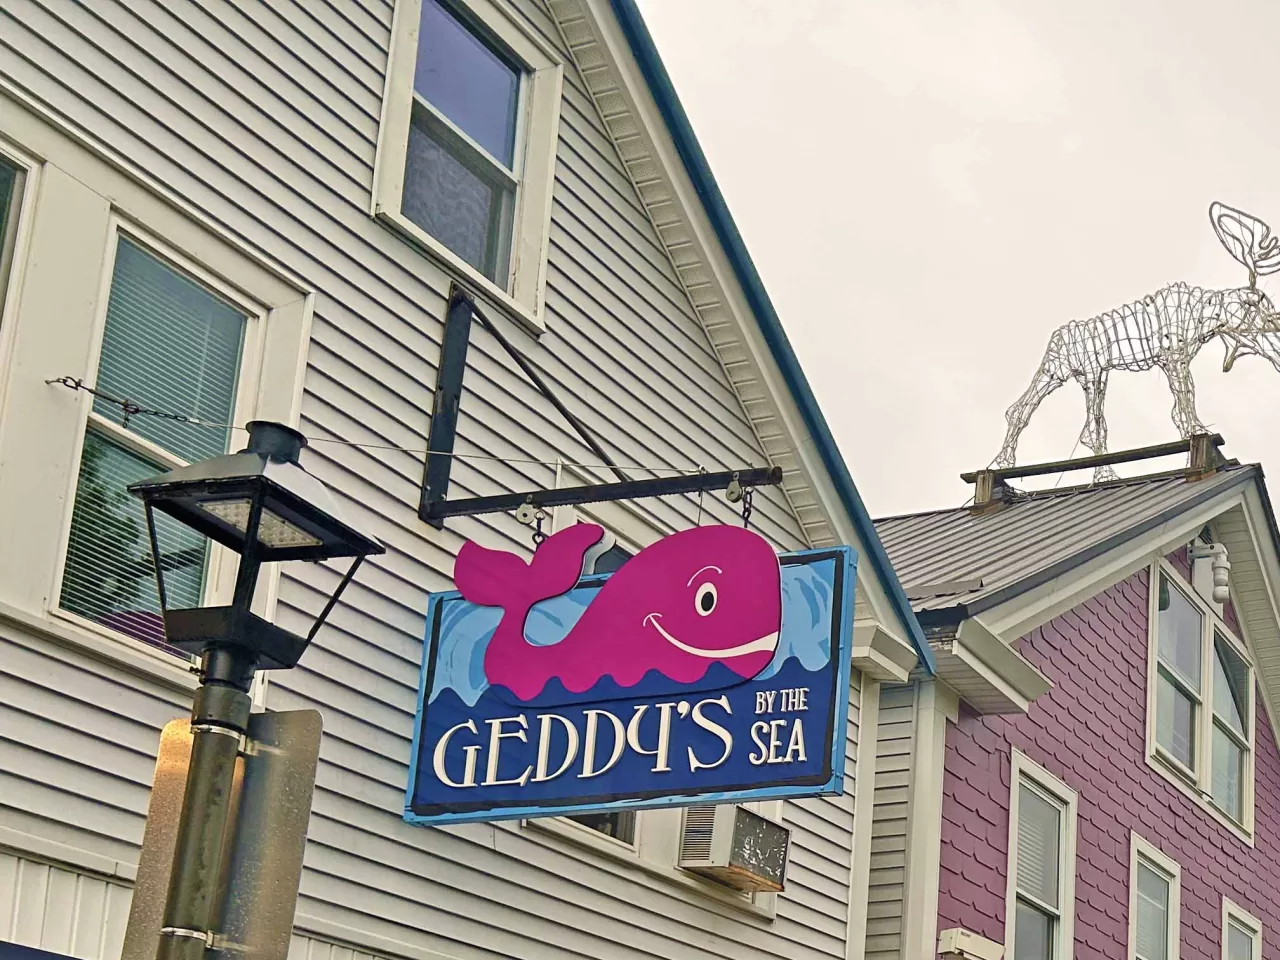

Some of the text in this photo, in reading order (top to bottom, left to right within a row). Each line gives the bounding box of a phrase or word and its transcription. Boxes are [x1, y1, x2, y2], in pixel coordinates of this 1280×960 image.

[755, 687, 811, 714] BY THE
[432, 694, 734, 788] GEDDY'S
[748, 718, 807, 766] SEA
